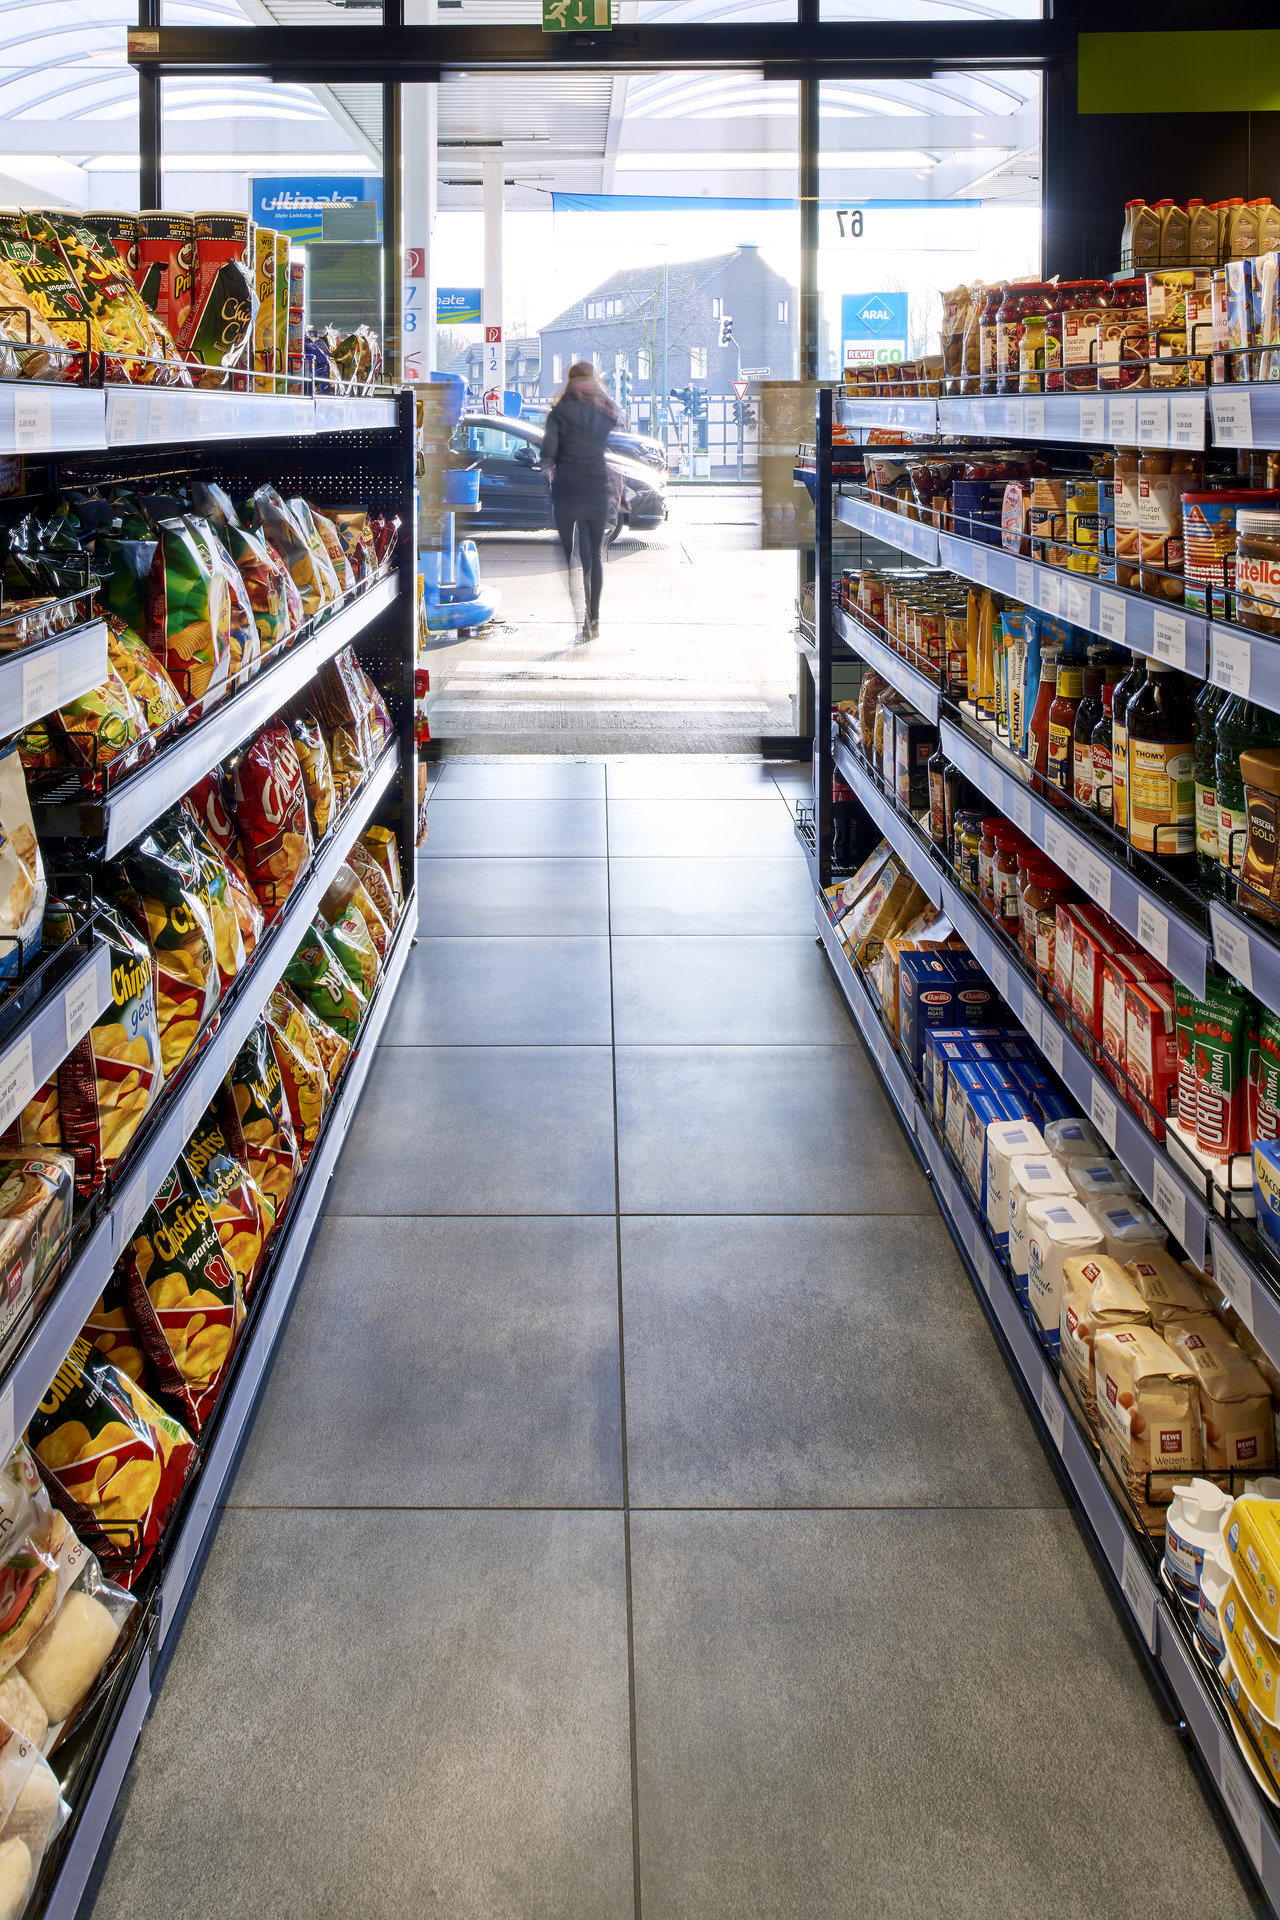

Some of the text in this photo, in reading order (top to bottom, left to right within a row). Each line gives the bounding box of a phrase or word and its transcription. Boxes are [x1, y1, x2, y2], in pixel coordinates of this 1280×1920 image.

[404, 286, 418, 306] 7
[404, 312, 416, 332] 8
[862, 310, 890, 320] ARAL
[490, 346, 495, 358] 1
[848, 349, 902, 363] REWE GO
[490, 360, 497, 370] 2
[1136, 750, 1164, 760] THOMY
[1252, 826, 1276, 843] GOLD
[1211, 1053, 1224, 1096] PARMA
[1202, 1078, 1210, 1093] DI
[1266, 1070, 1278, 1115] PARMA
[1198, 1089, 1224, 1145] ORO
[1237, 1440, 1255, 1448] REWE
[1154, 1456, 1188, 1466] Weizen-
[68, 1554, 76, 1566] 6
